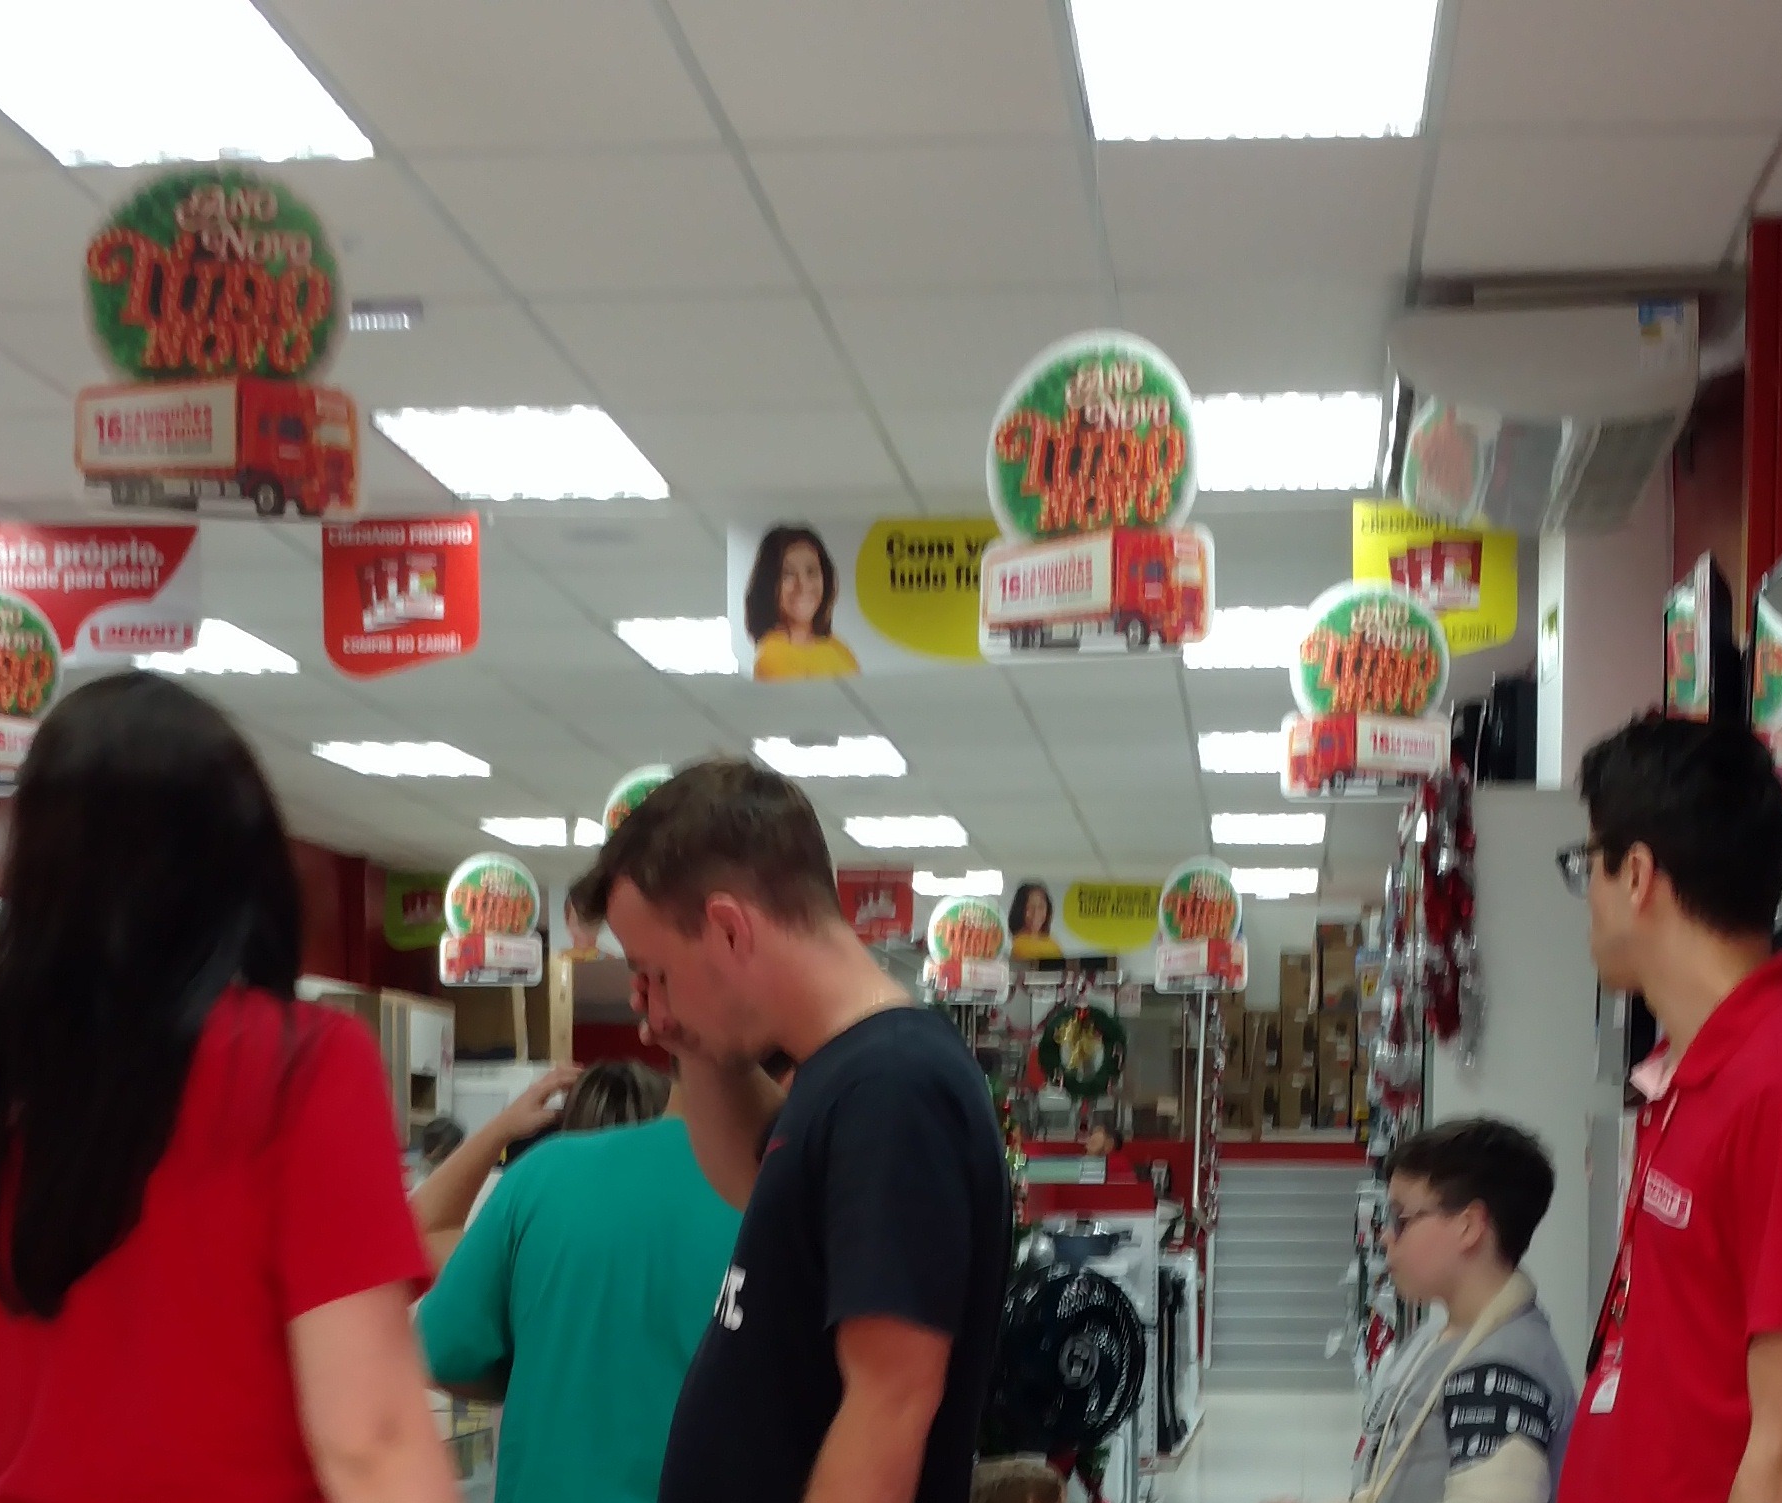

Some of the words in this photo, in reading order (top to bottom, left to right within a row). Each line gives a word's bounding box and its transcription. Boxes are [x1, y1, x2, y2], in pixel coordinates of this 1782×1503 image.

[96, 412, 122, 444] 16
[64, 569, 107, 594] para
[1000, 570, 1020, 601] 16
